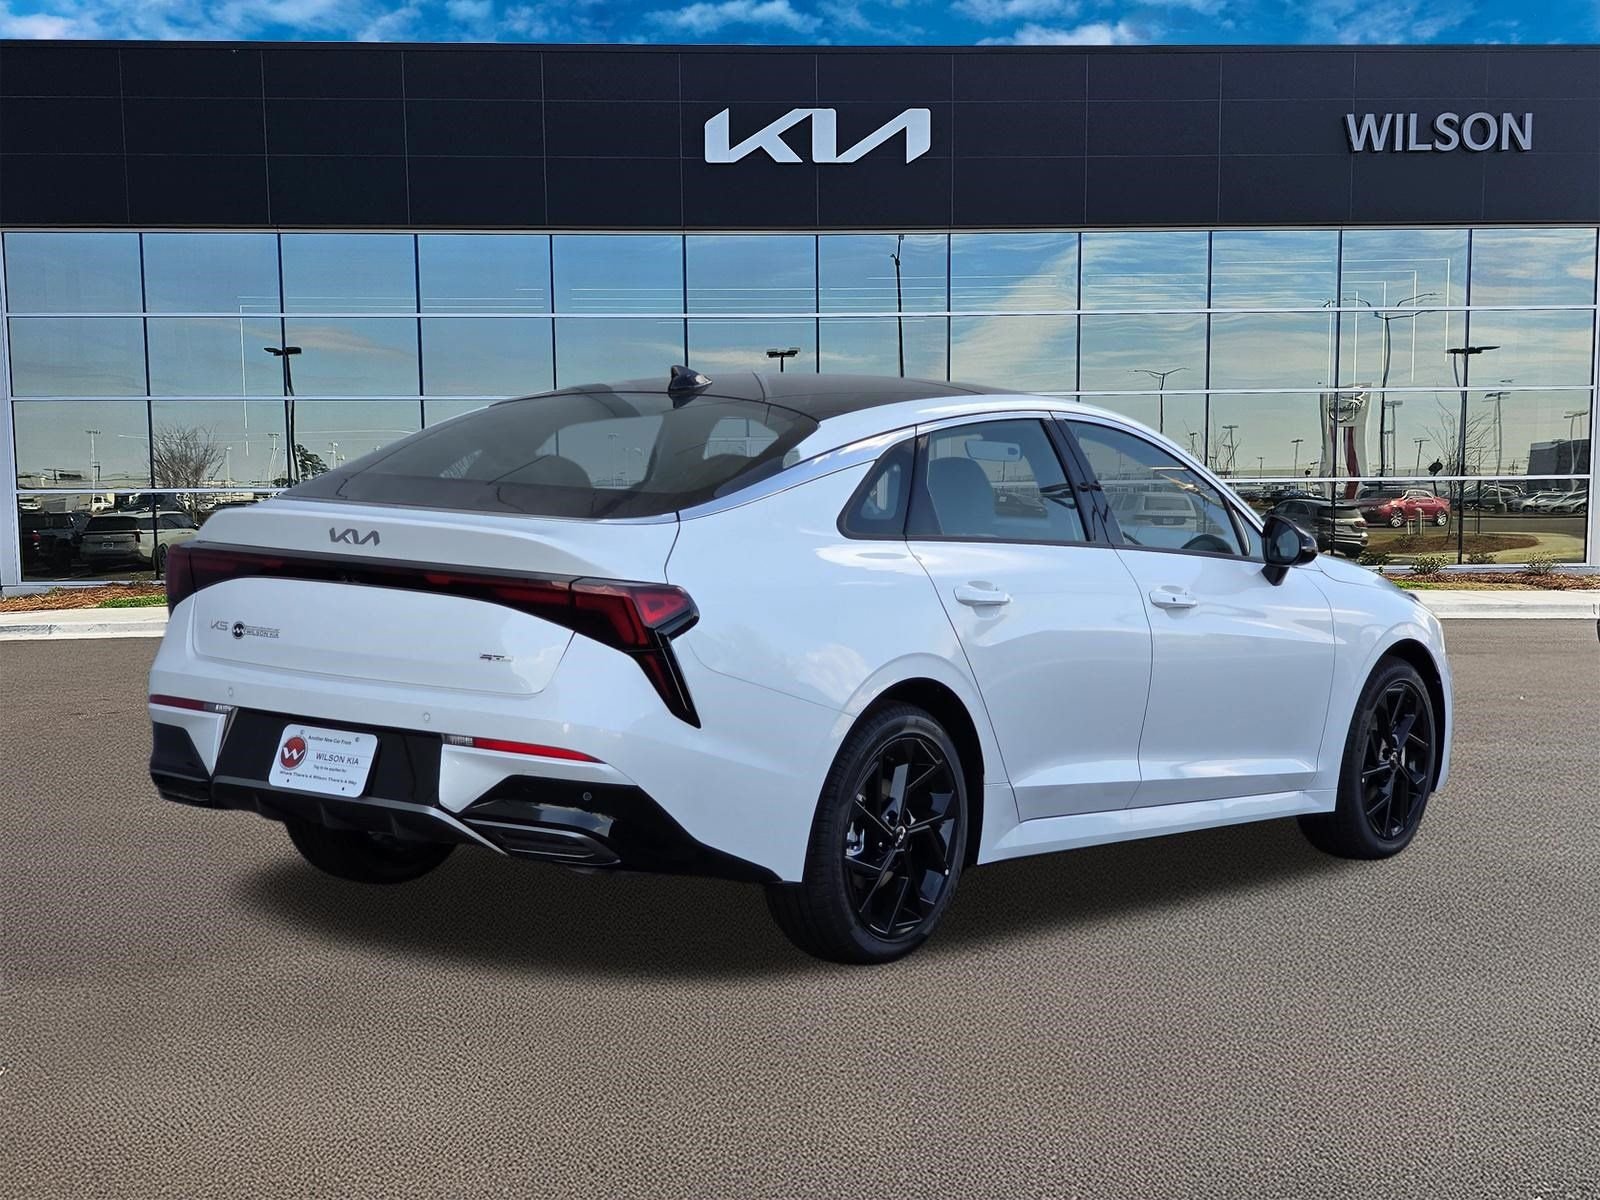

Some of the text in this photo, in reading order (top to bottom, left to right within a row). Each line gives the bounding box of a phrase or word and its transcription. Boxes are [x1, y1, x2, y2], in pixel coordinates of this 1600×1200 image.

[704, 107, 931, 164] KIA
[1344, 112, 1533, 152] WILSON
[329, 527, 380, 546] KIA
[316, 752, 359, 765] WILSON KIA
